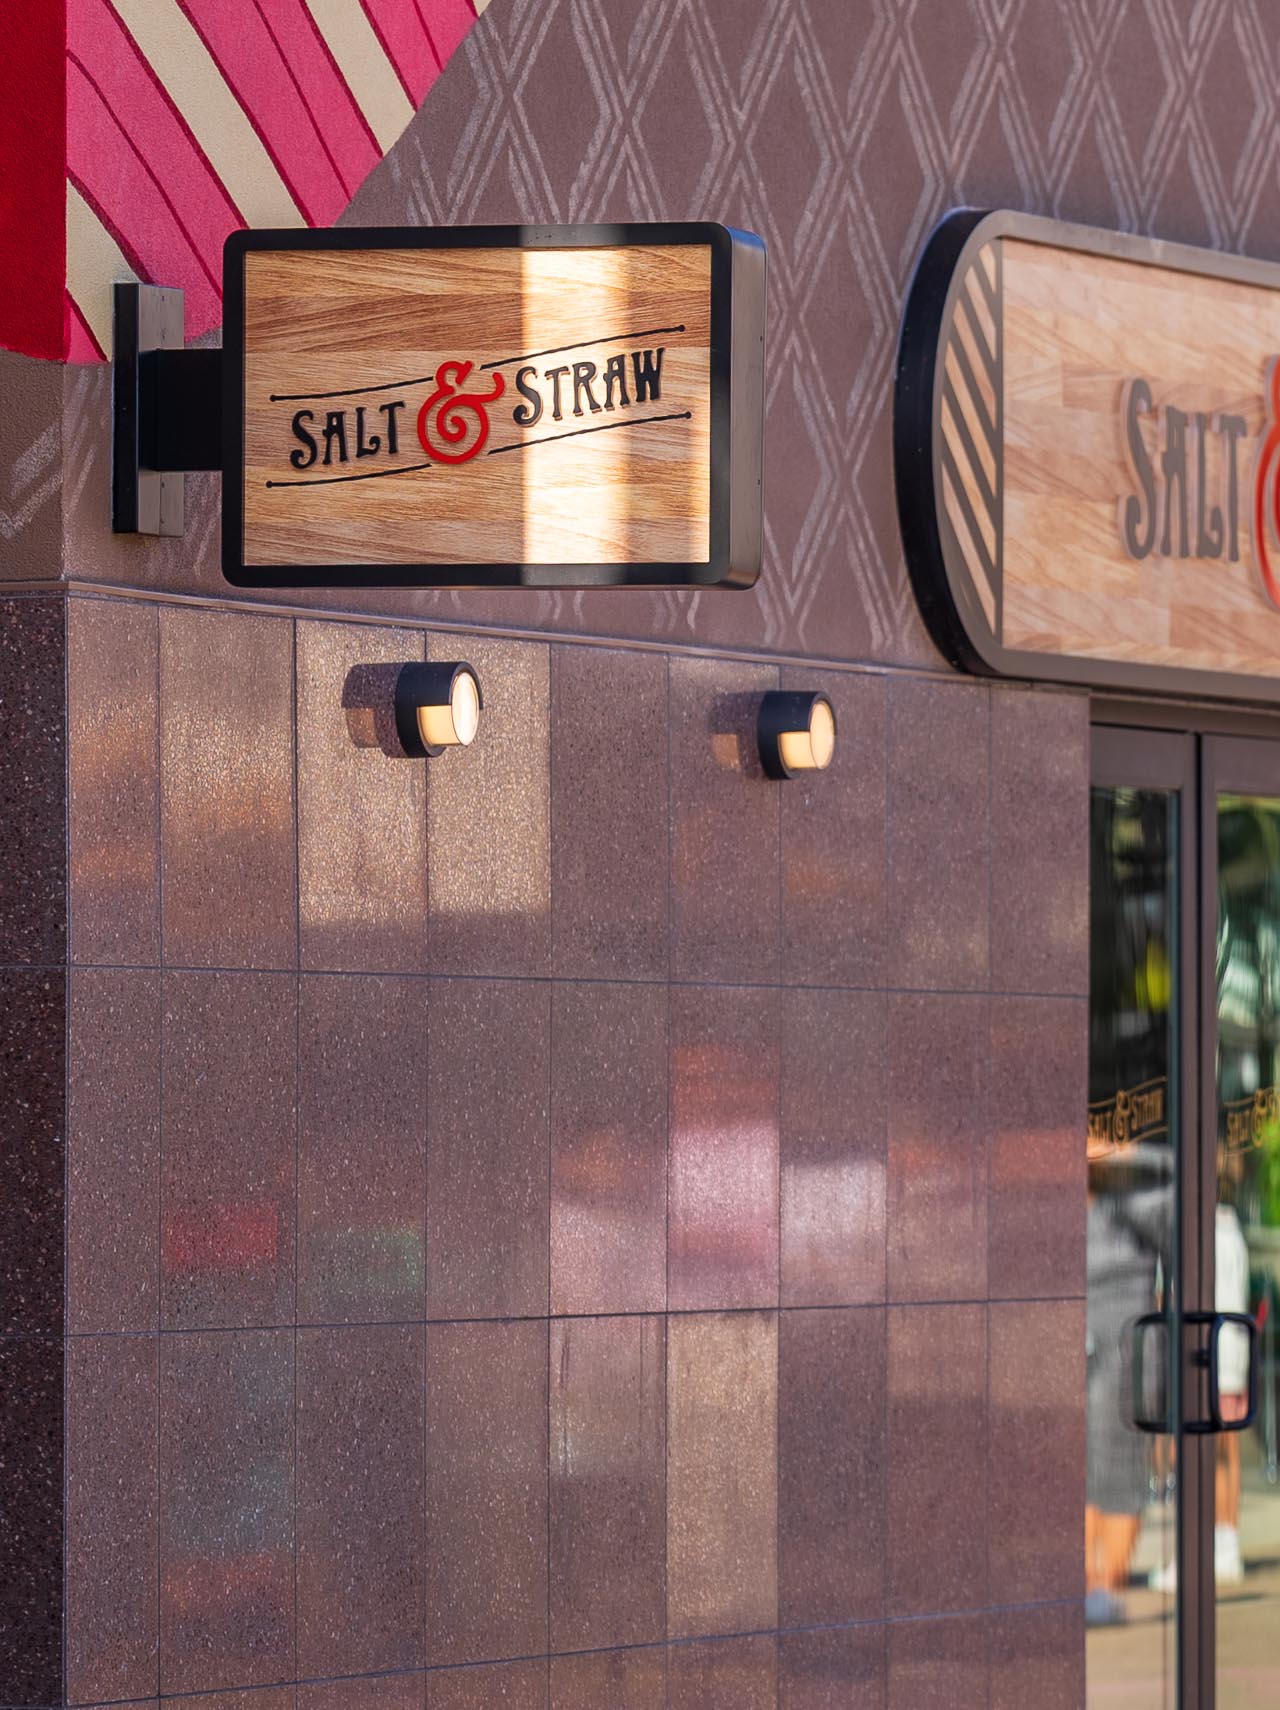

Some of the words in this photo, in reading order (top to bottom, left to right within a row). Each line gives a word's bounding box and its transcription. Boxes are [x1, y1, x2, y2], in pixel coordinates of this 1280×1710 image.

[290, 401, 406, 469] SALT
[417, 360, 505, 464] &
[512, 347, 665, 428] STRAW
[1119, 377, 1247, 562] SALT
